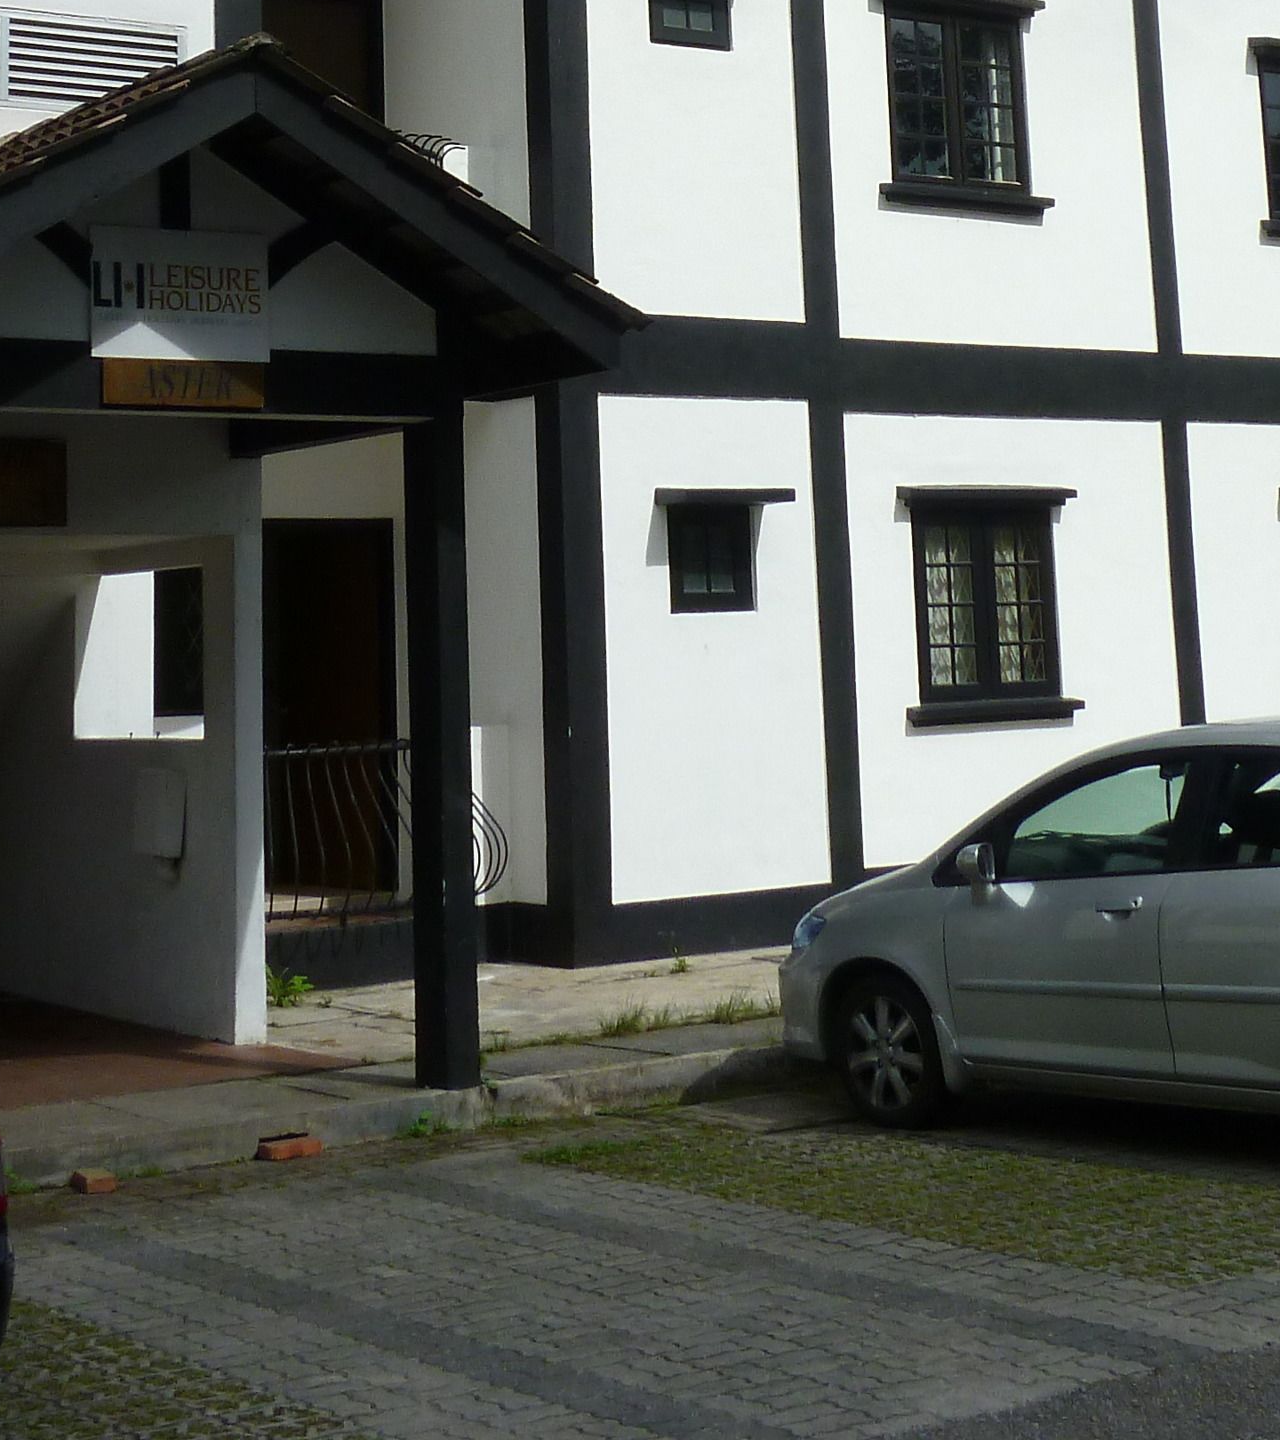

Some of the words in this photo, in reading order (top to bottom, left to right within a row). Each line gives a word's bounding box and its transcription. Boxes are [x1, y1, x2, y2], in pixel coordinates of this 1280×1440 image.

[149, 263, 261, 293] LEISURE
[149, 290, 262, 315] HOLIDAYS
[140, 364, 234, 401] ASTER
